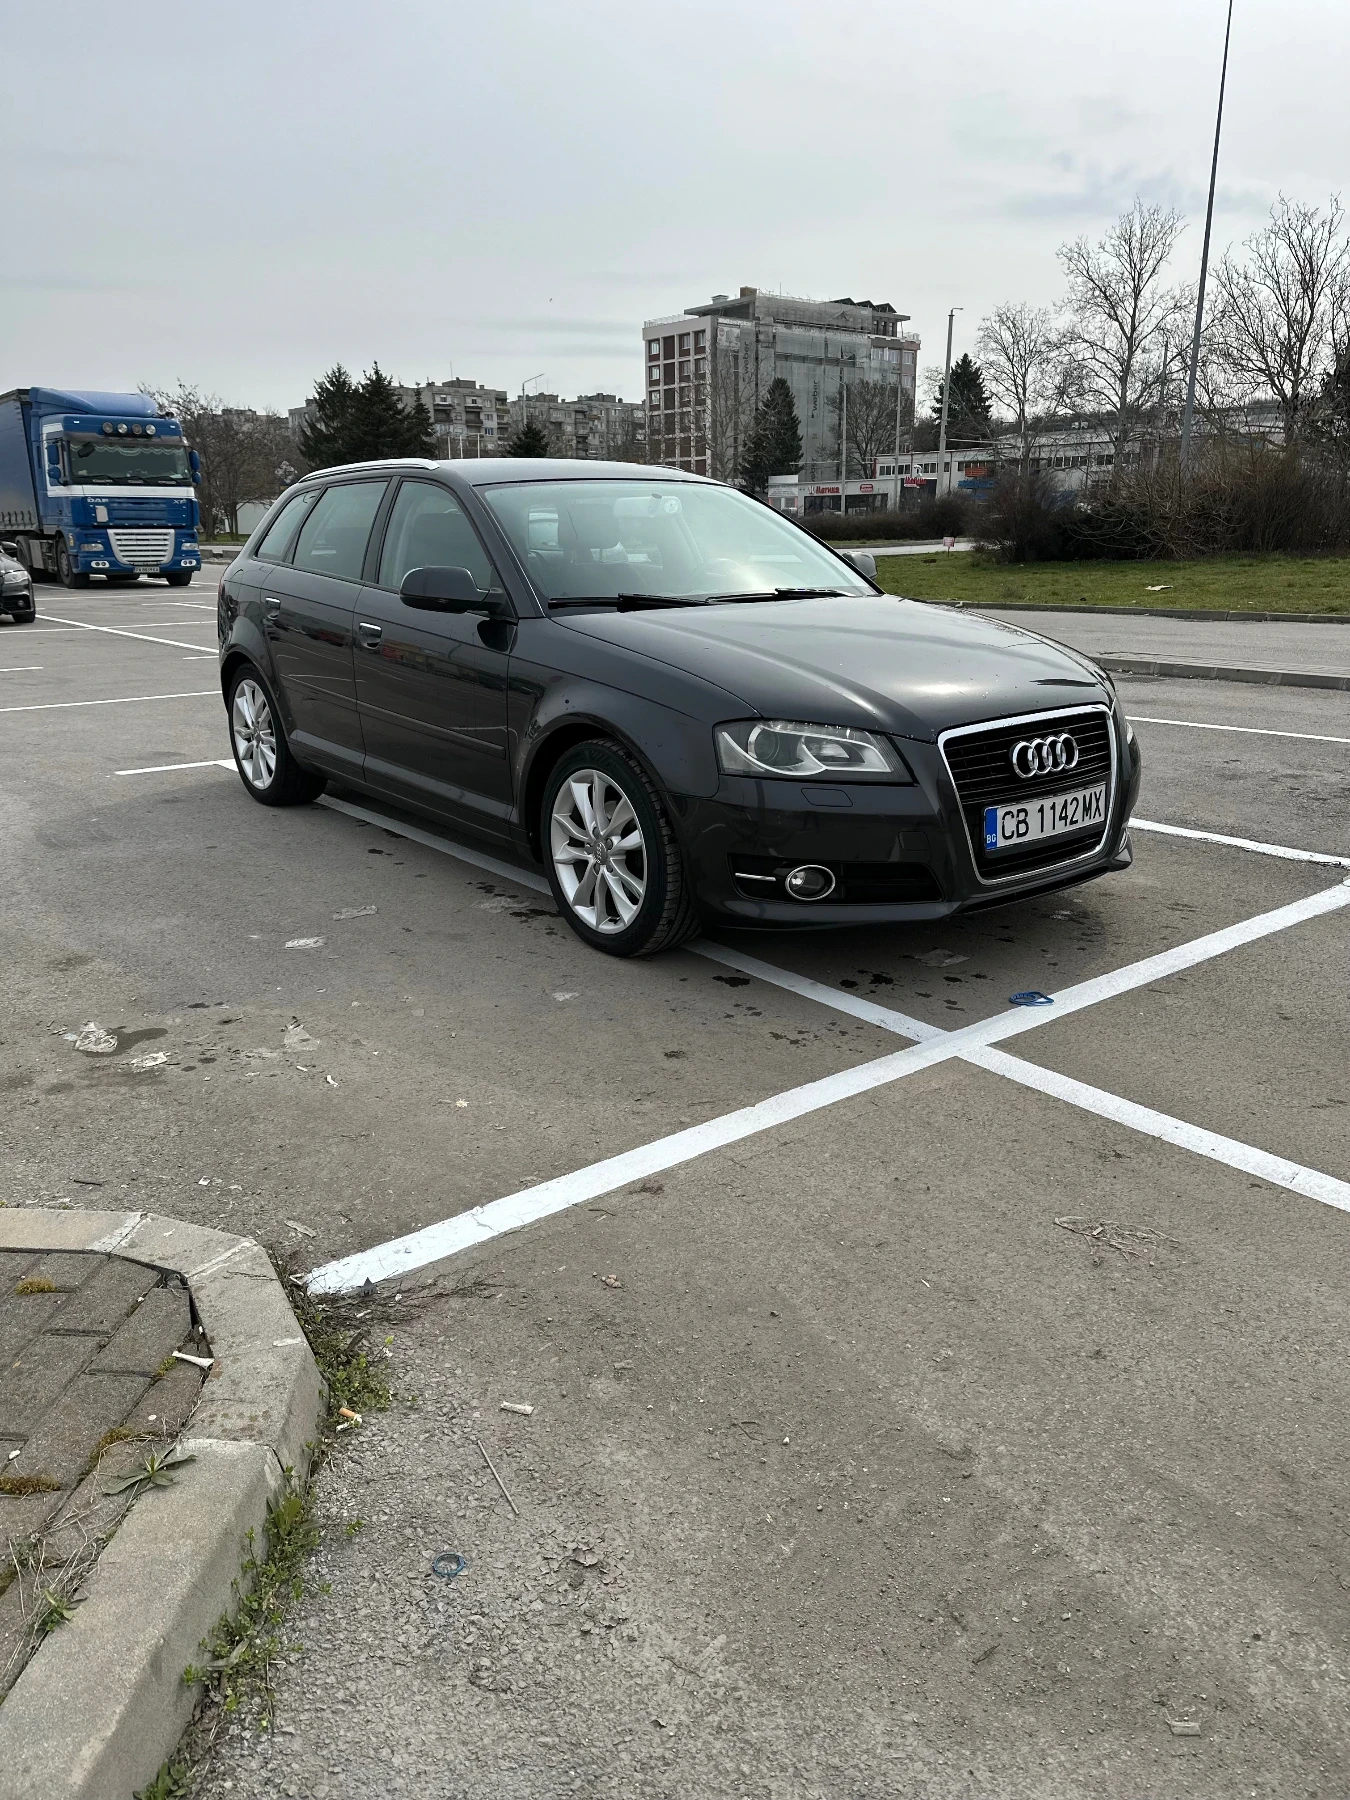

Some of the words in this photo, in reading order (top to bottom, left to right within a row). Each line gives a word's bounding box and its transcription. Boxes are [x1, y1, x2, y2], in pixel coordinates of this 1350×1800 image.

[742, 341, 750, 374] weber
[1001, 808, 1029, 840] CB
[1037, 797, 1079, 833] 1142
[1082, 789, 1103, 822] MX
[986, 834, 997, 844] BG
